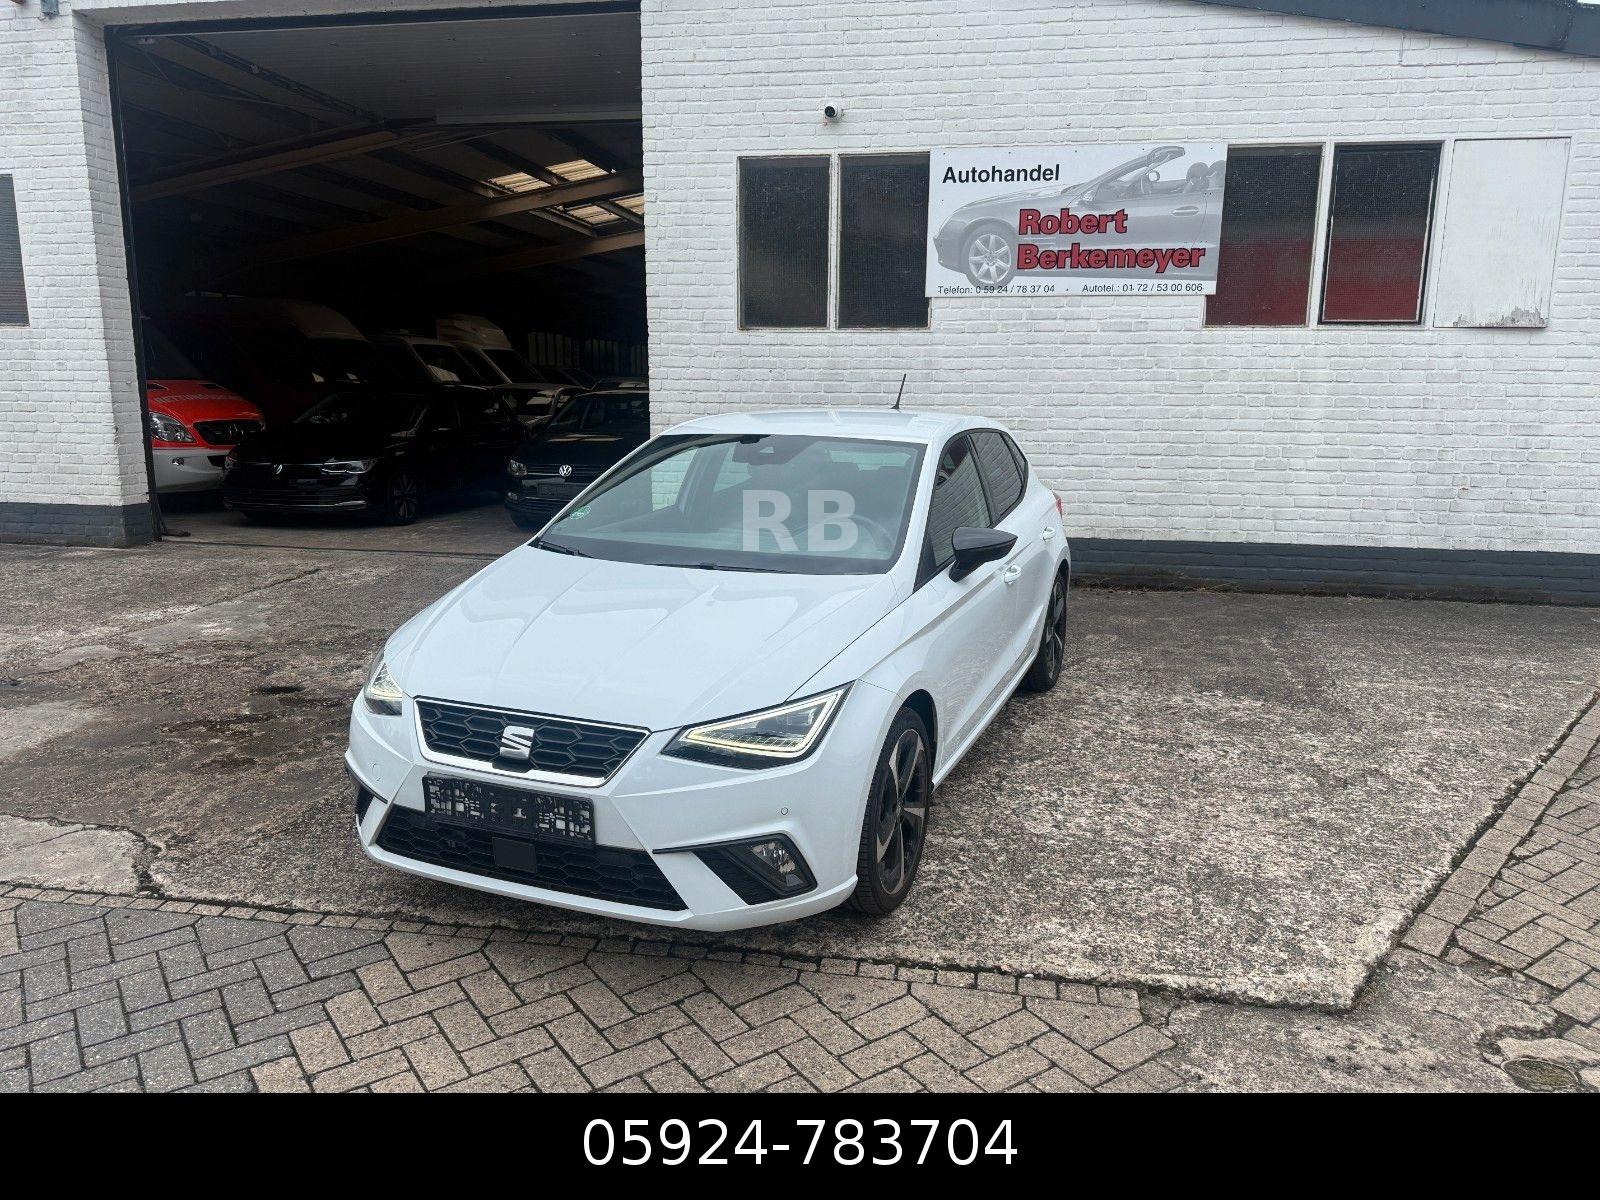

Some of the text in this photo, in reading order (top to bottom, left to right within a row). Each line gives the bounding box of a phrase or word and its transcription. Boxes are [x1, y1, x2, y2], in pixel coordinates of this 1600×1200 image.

[942, 164, 1060, 184] Autohandel
[1018, 208, 1129, 236] Robert
[1016, 243, 1206, 273] Berkemeyer
[938, 285, 973, 295] Telefon:
[983, 285, 995, 294] 59
[997, 285, 1008, 294] 24
[1043, 284, 1055, 293] 04
[1137, 283, 1148, 292] 72
[1156, 283, 1168, 292] 53
[1170, 283, 1182, 292] 00
[1185, 283, 1203, 292] 606
